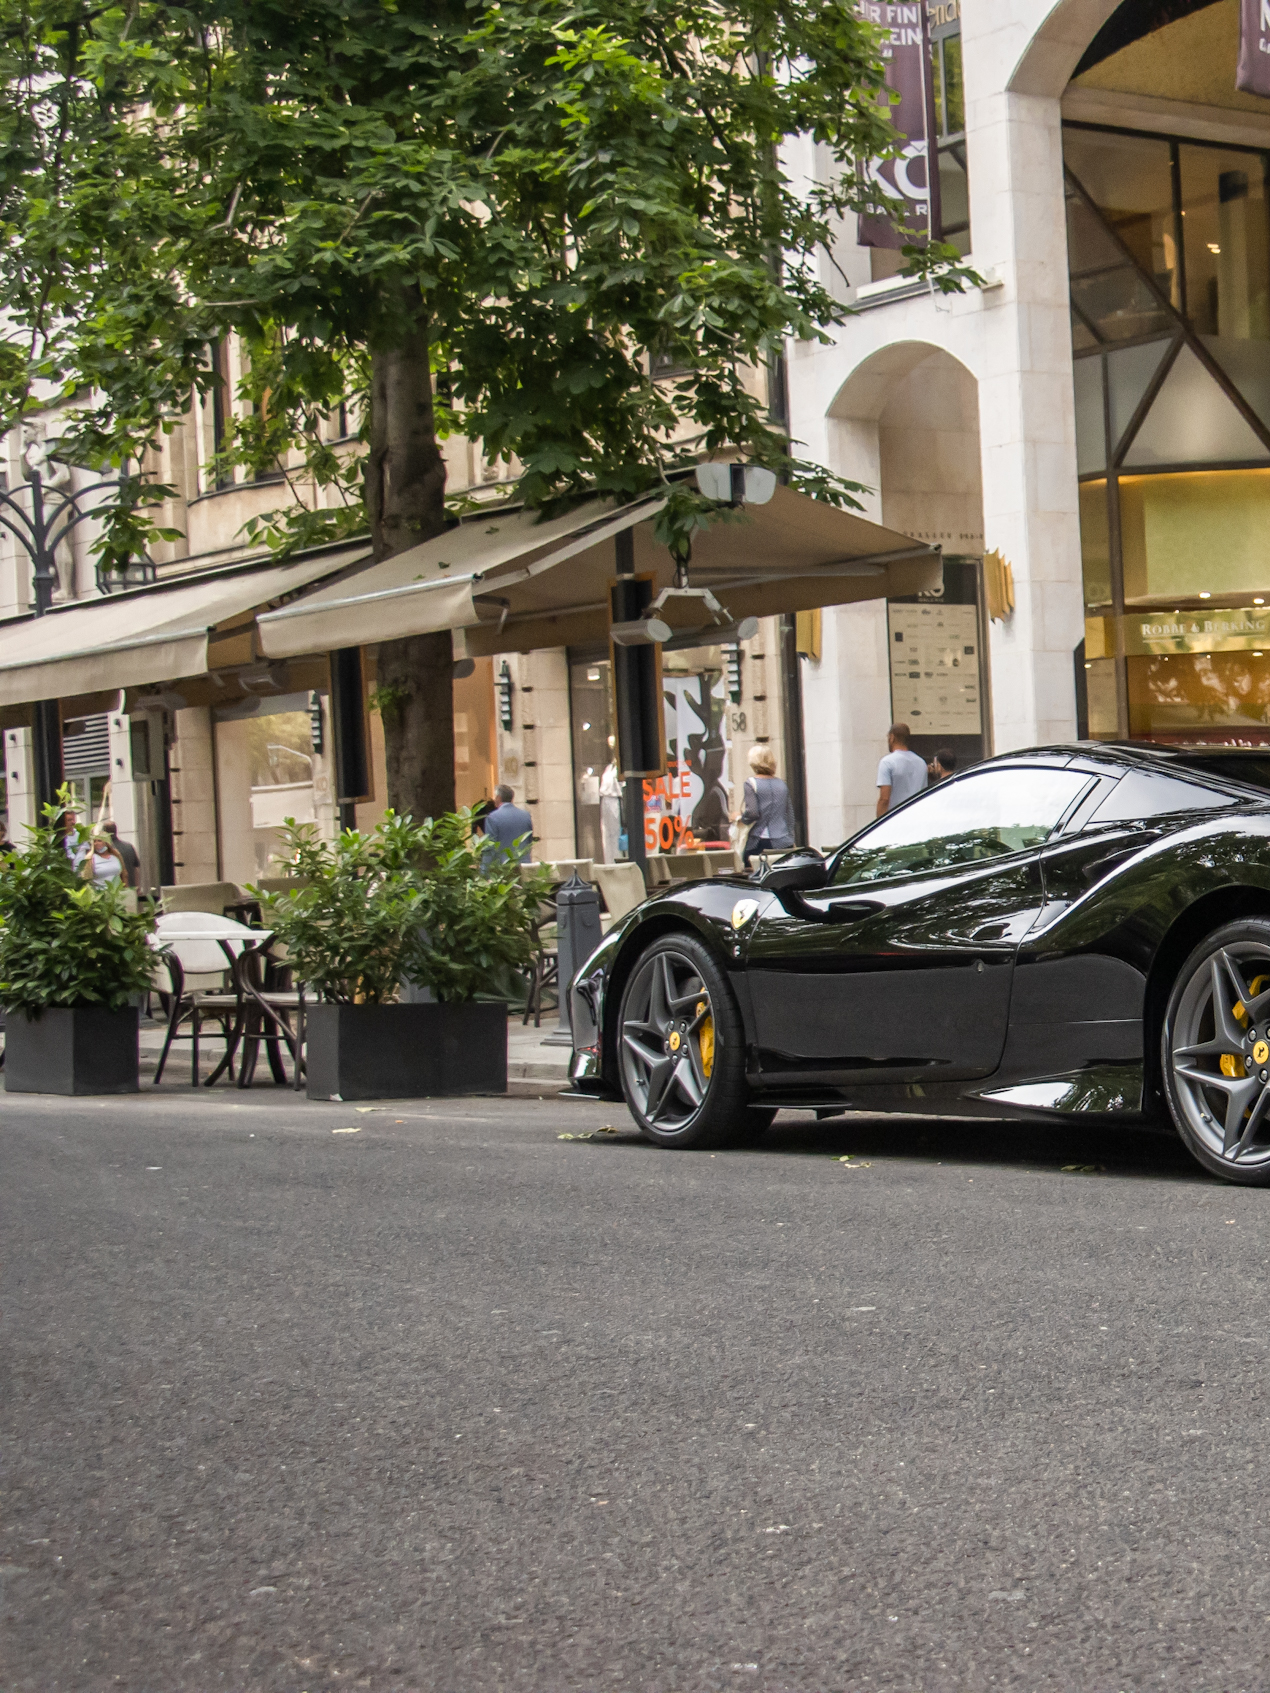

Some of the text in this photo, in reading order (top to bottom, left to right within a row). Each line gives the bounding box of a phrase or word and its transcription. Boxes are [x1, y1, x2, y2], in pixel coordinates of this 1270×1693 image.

[731, 712, 747, 732] 58
[642, 771, 693, 801] SALE
[644, 814, 695, 850] 50%
